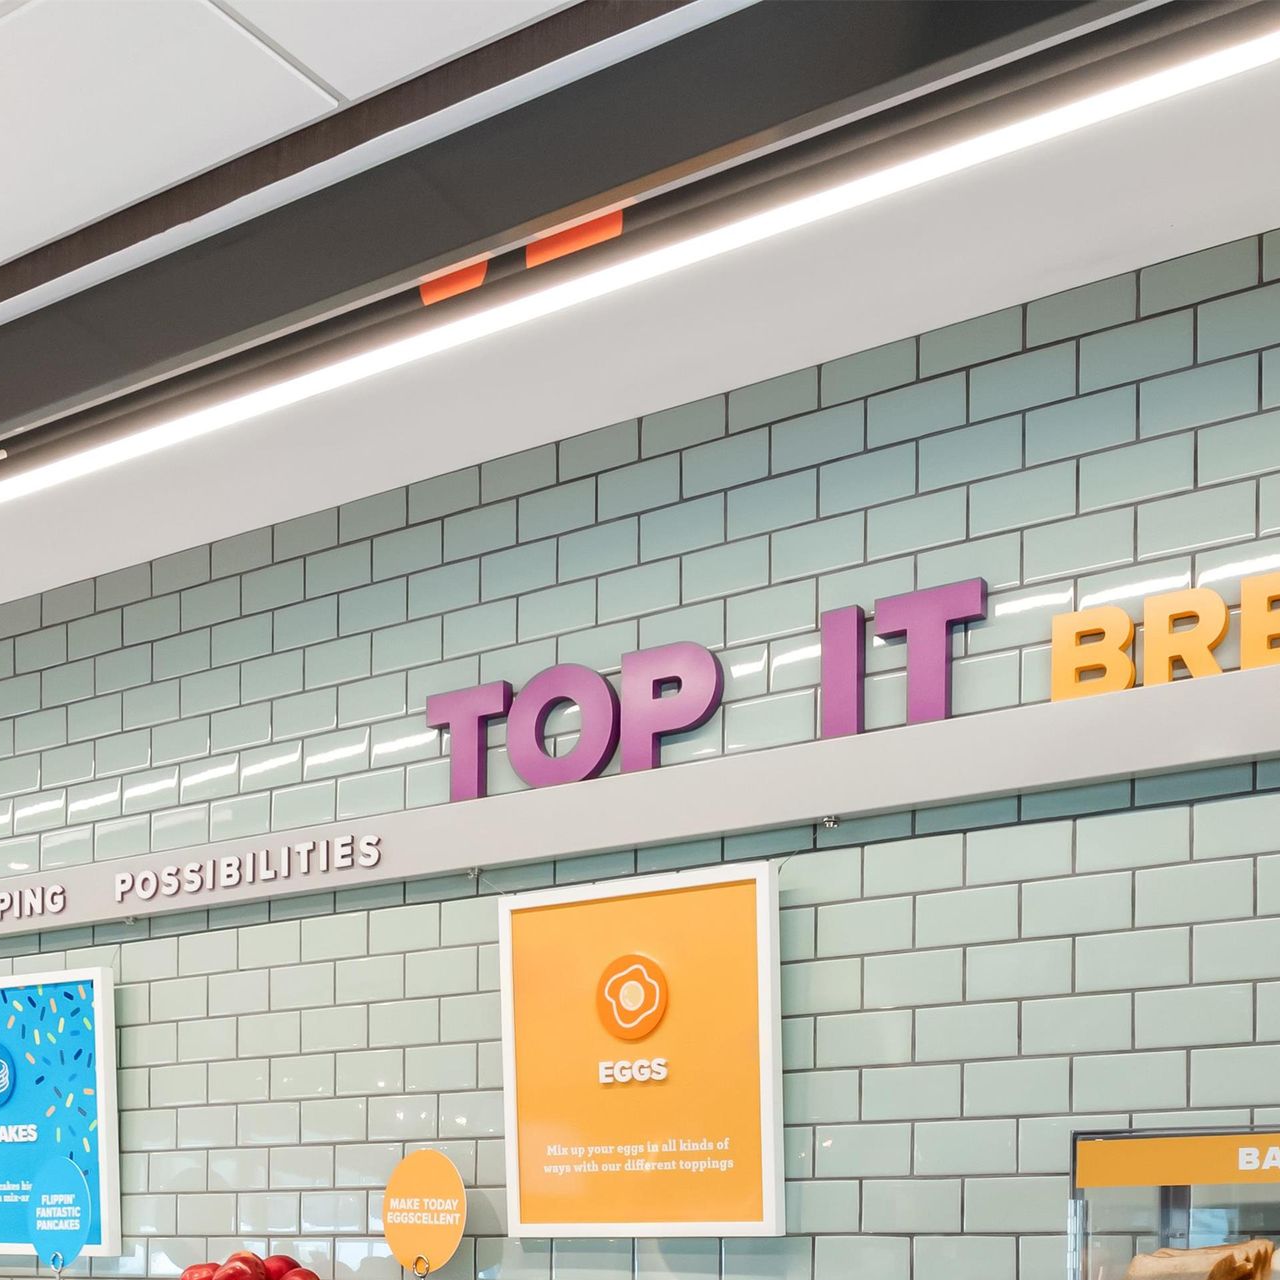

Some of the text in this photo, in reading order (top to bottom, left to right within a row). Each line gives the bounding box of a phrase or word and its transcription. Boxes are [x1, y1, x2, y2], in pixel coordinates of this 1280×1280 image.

[426, 640, 723, 801] TOP
[820, 577, 988, 740] IT
[115, 834, 381, 901] POSSIBILITIES
[598, 1058, 668, 1083] EGGS
[547, 1137, 730, 1157] Mix up your eggs in all kinds of
[544, 1157, 734, 1176] ways with our different toppings
[36, 1206, 81, 1218] FANTASTIC
[390, 1198, 459, 1211] MAKE TODAY
[36, 1219, 81, 1231] PANCAKES
[387, 1211, 461, 1225] EGGSCELLENT
